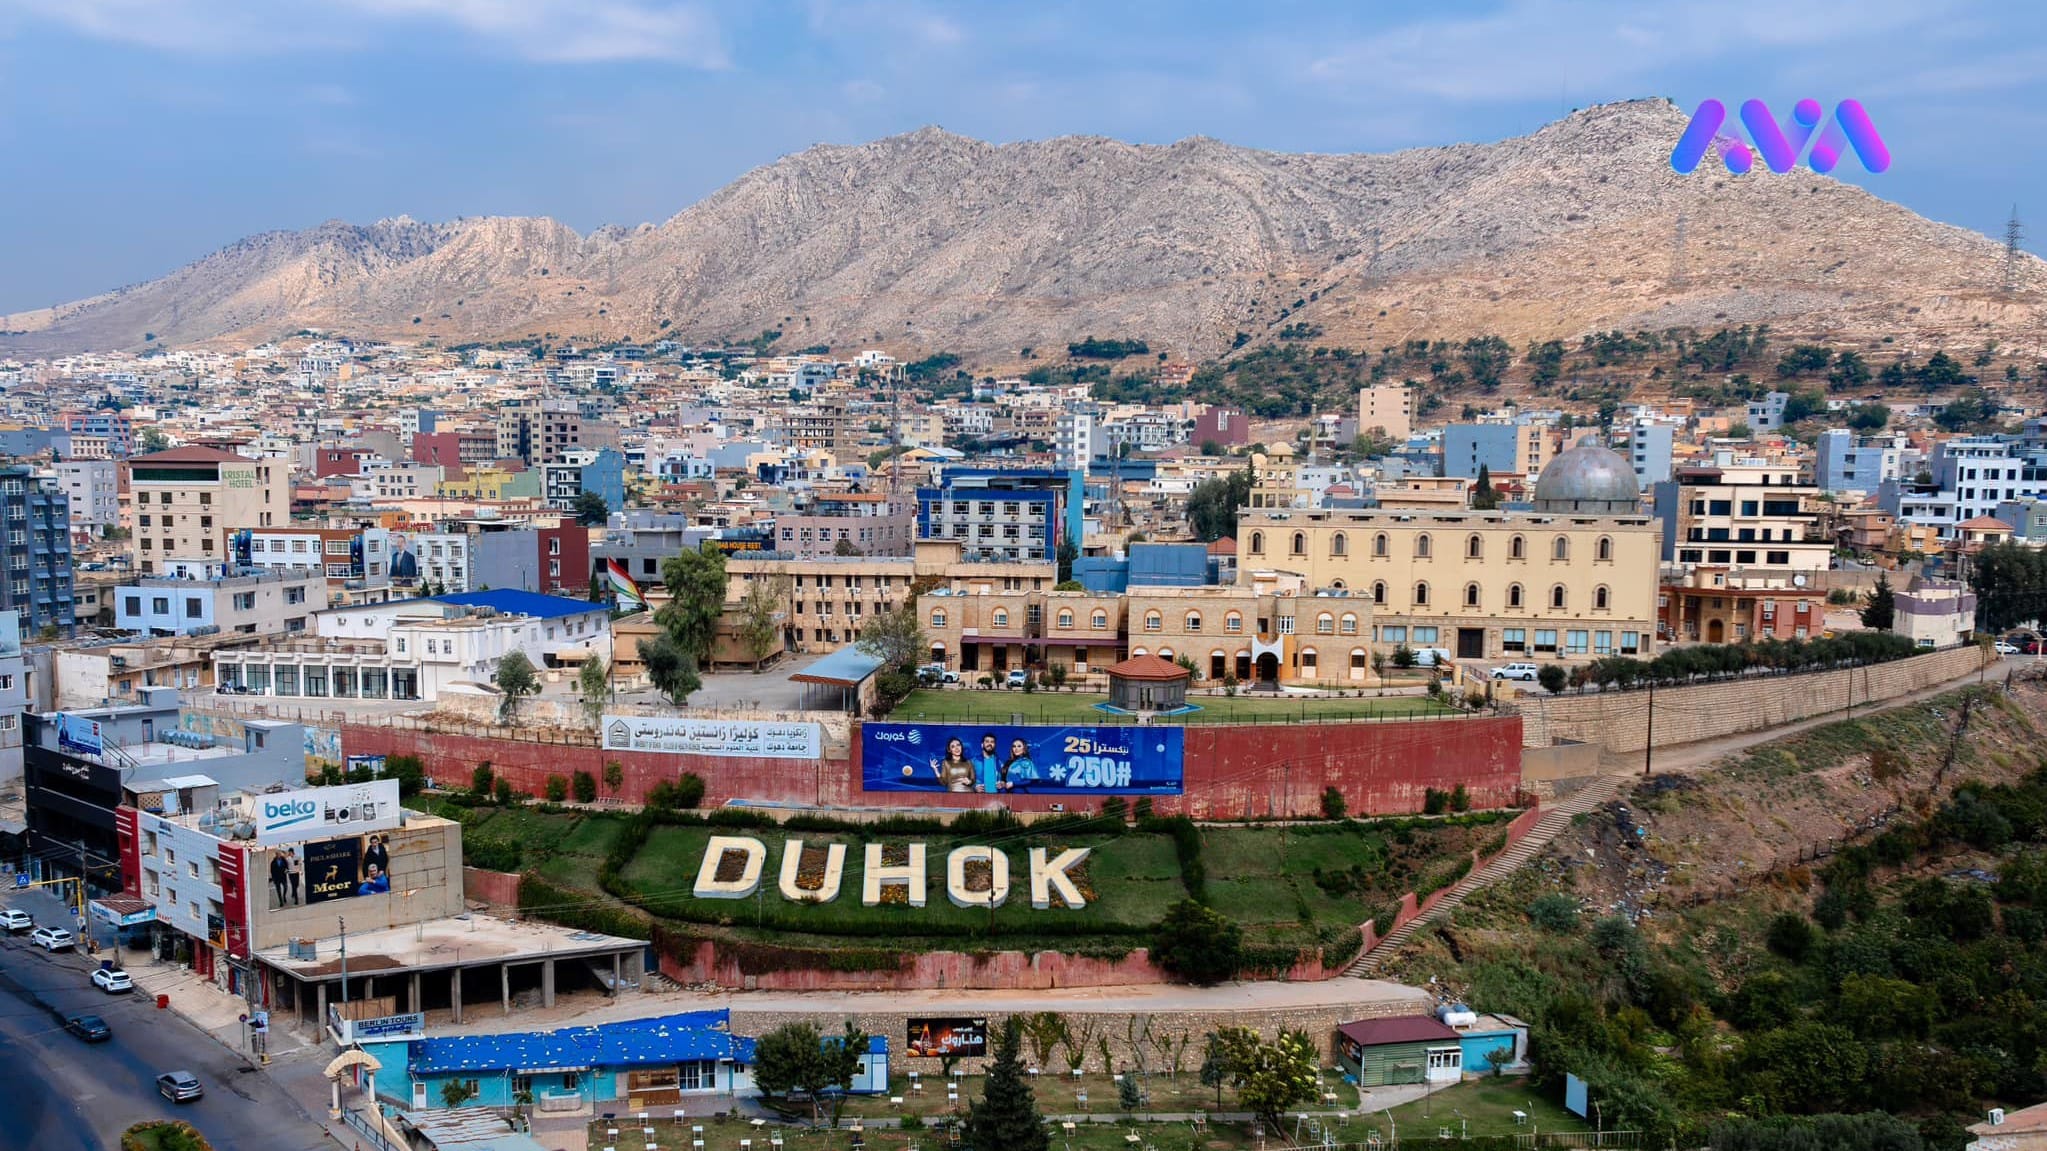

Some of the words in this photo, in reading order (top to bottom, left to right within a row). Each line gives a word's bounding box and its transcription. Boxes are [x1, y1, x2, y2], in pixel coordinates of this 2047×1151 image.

[222, 470, 256, 479] KRISTAL
[229, 479, 254, 488] HOTEL
[1063, 736, 1092, 754] 25
[264, 799, 316, 819] beko
[693, 836, 1092, 910] DUHOK
[312, 881, 352, 894] Meer
[358, 1019, 389, 1028] BERLIN
[391, 1014, 419, 1024] TOURS
